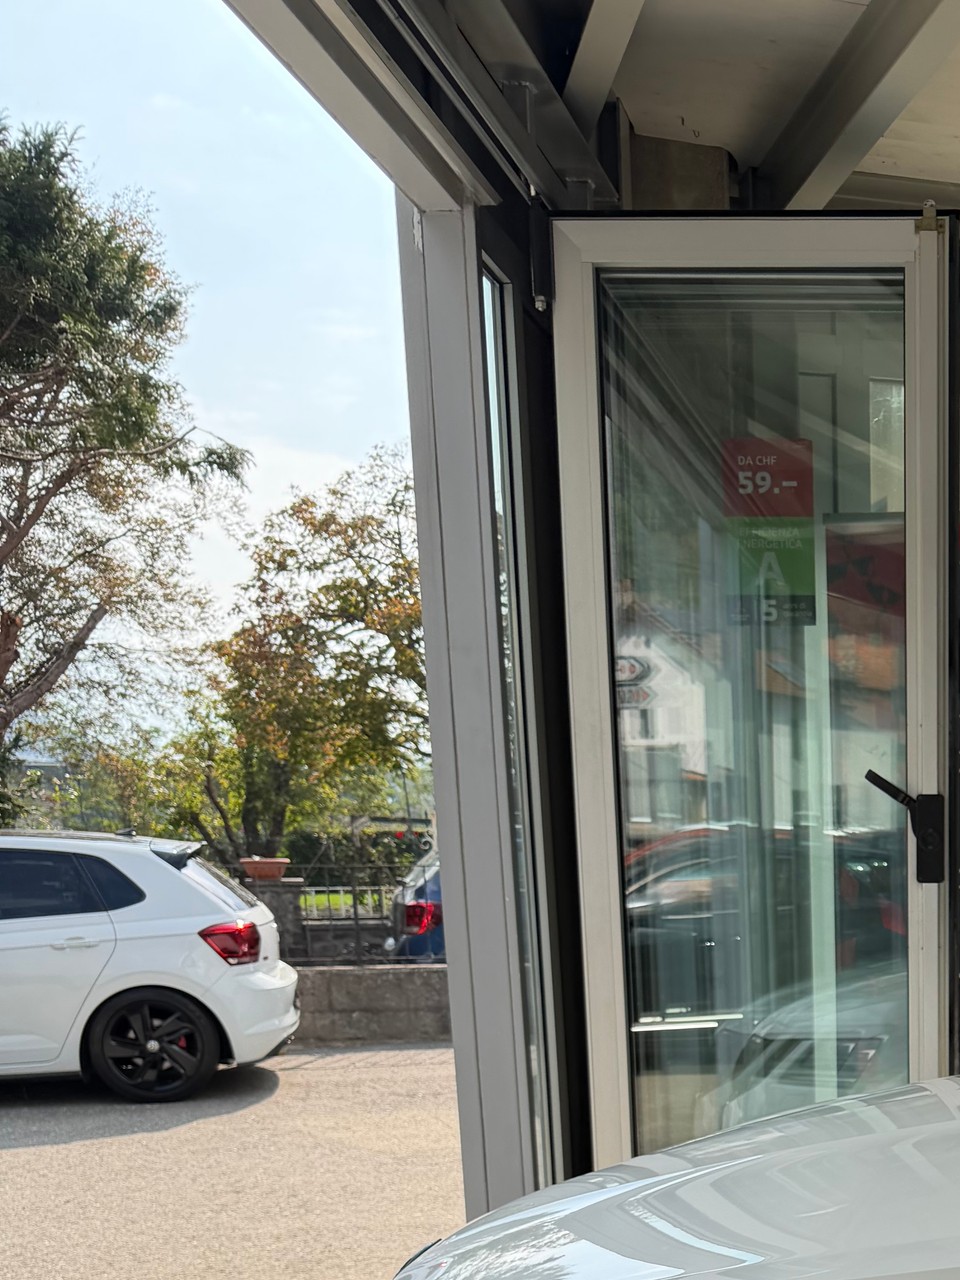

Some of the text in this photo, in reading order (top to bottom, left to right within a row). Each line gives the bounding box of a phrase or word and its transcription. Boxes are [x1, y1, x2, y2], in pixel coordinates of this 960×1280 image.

[737, 455, 777, 466] DA CHF
[761, 599, 779, 622] 5
